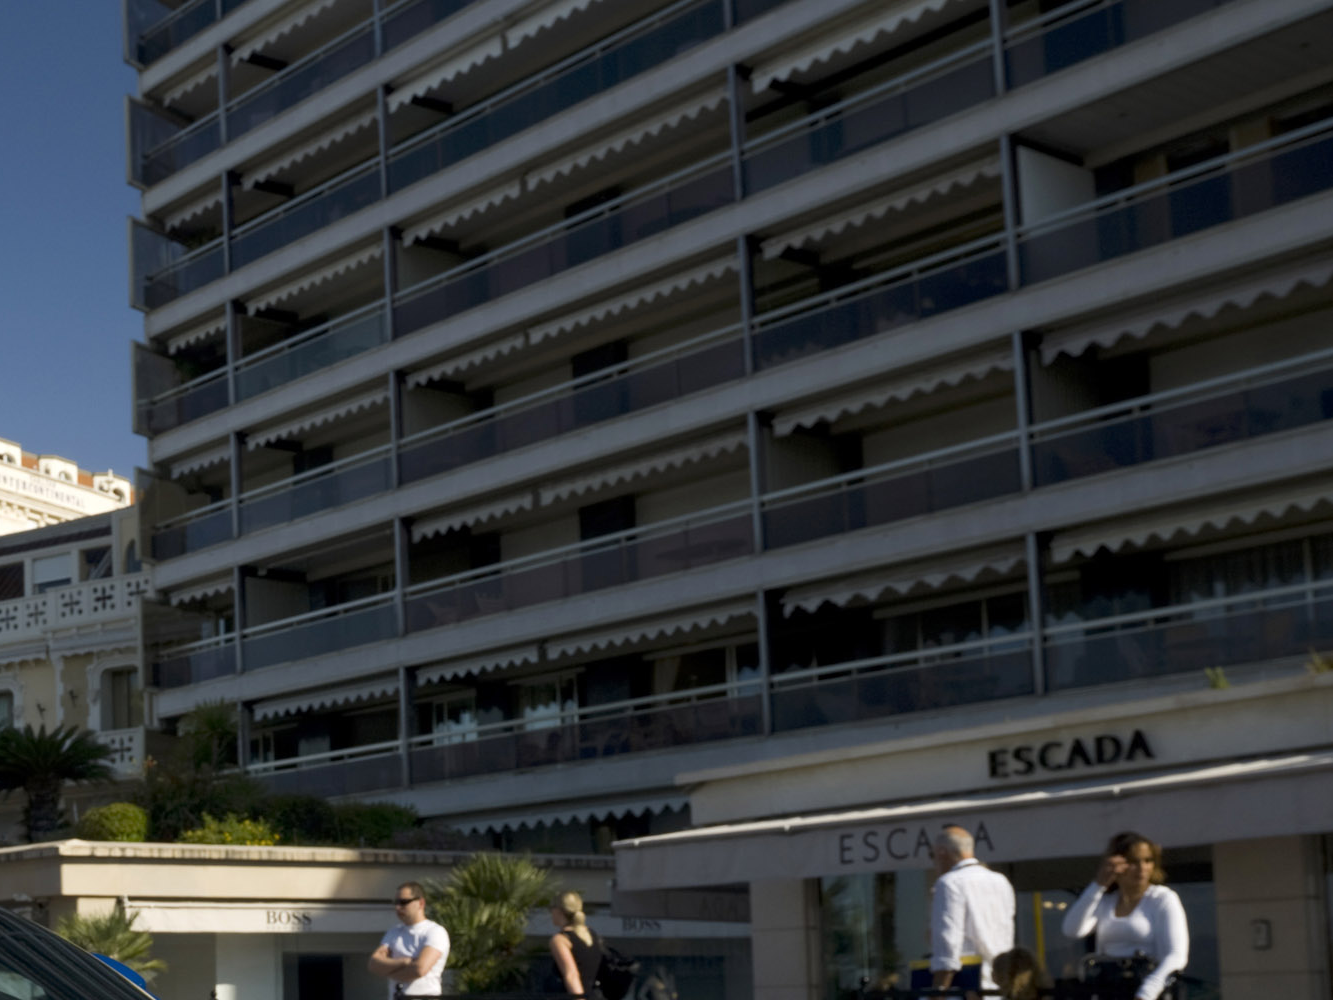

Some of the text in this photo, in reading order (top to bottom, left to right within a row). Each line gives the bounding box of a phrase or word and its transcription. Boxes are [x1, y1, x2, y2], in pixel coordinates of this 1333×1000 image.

[988, 729, 1154, 778] ESCADA
[839, 821, 995, 864] ESCAA
[266, 910, 312, 926] BOSS
